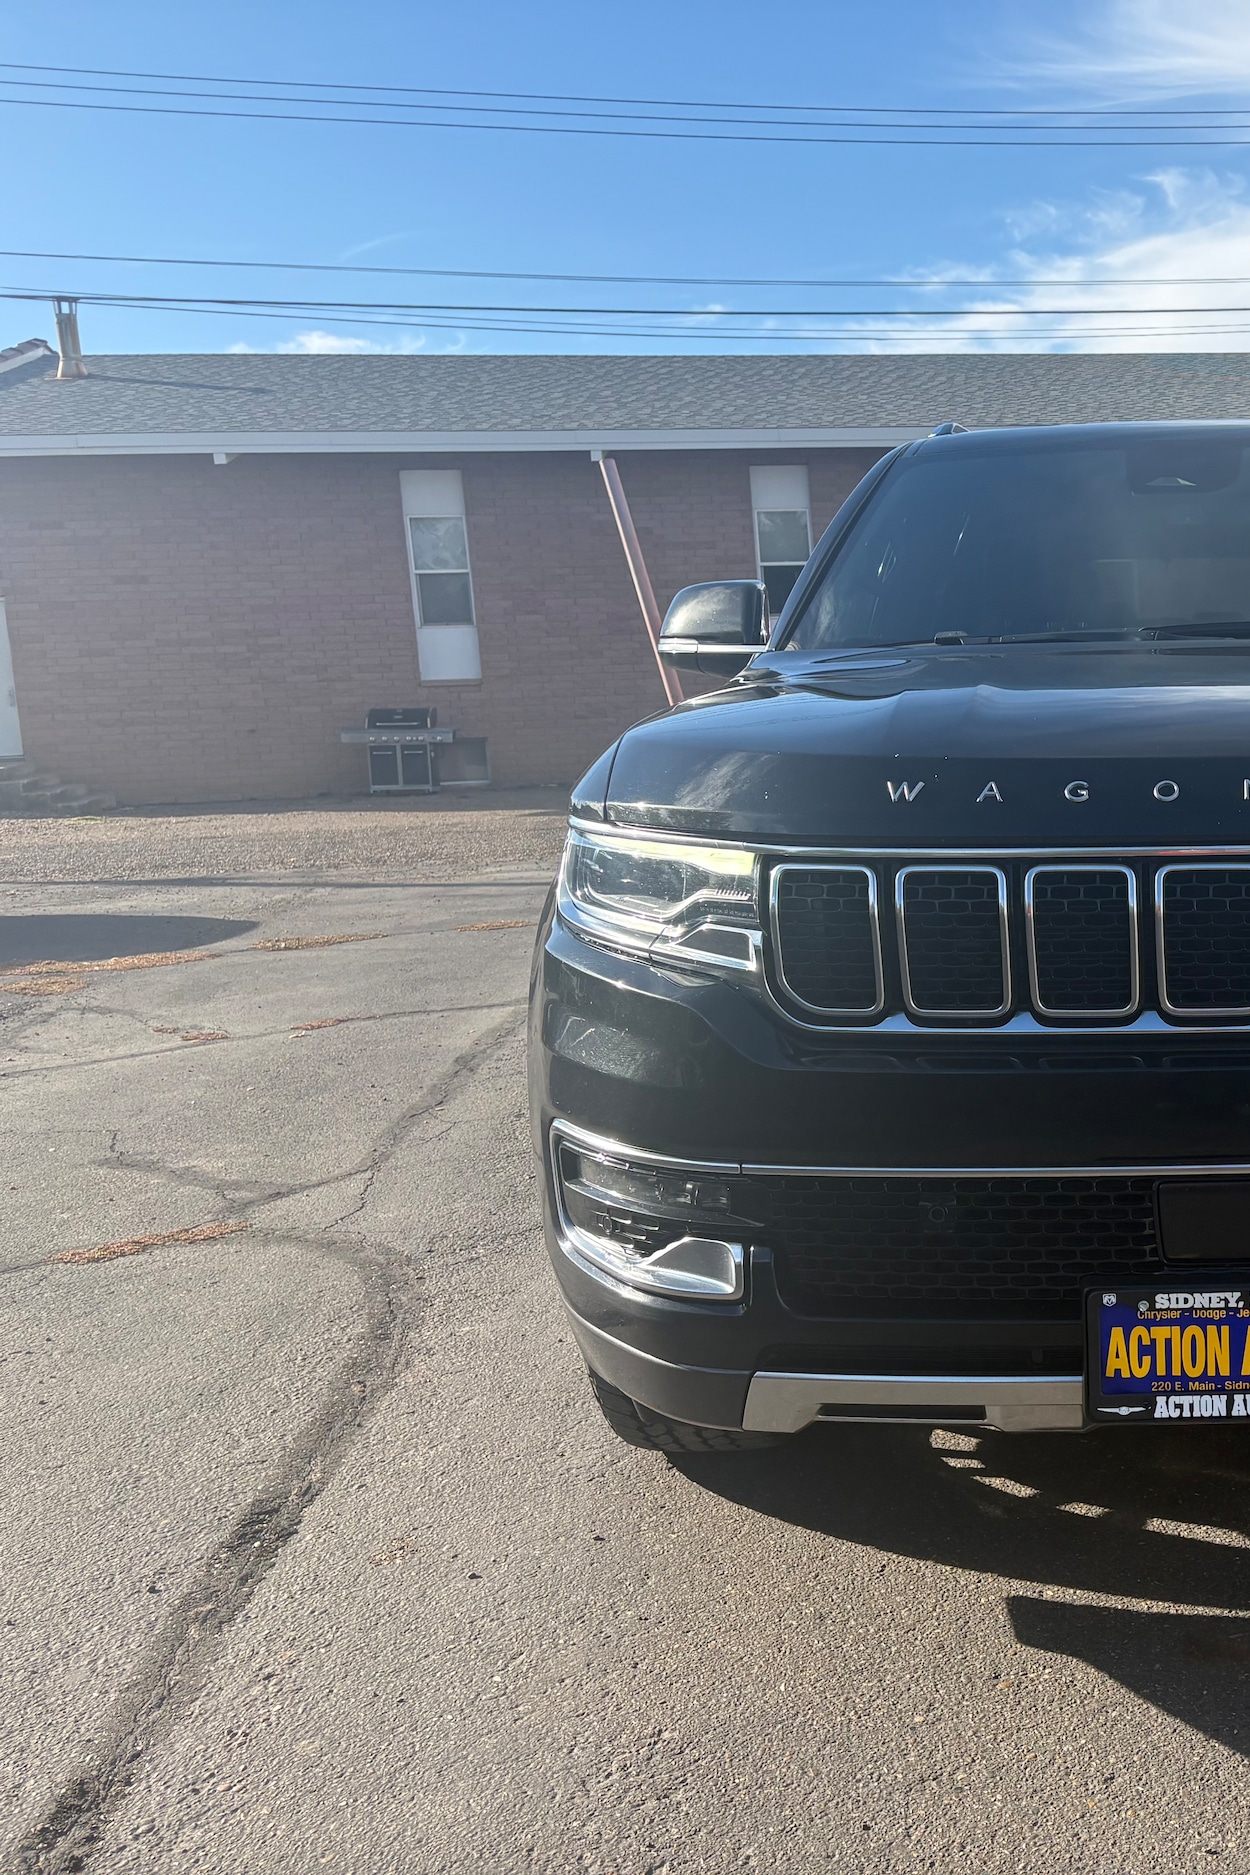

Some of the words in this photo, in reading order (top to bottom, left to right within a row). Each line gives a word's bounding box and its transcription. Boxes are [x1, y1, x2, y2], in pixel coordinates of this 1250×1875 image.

[1155, 1292, 1245, 1309] SIDNEY,
[1137, 1309, 1182, 1321] Chrysler
[1193, 1309, 1226, 1319] Dodge
[1105, 1325, 1230, 1378] ACTION
[1151, 1381, 1172, 1392] 220
[1174, 1381, 1185, 1392] E.
[1188, 1380, 1216, 1391] Main
[1153, 1394, 1228, 1419] ACTION
